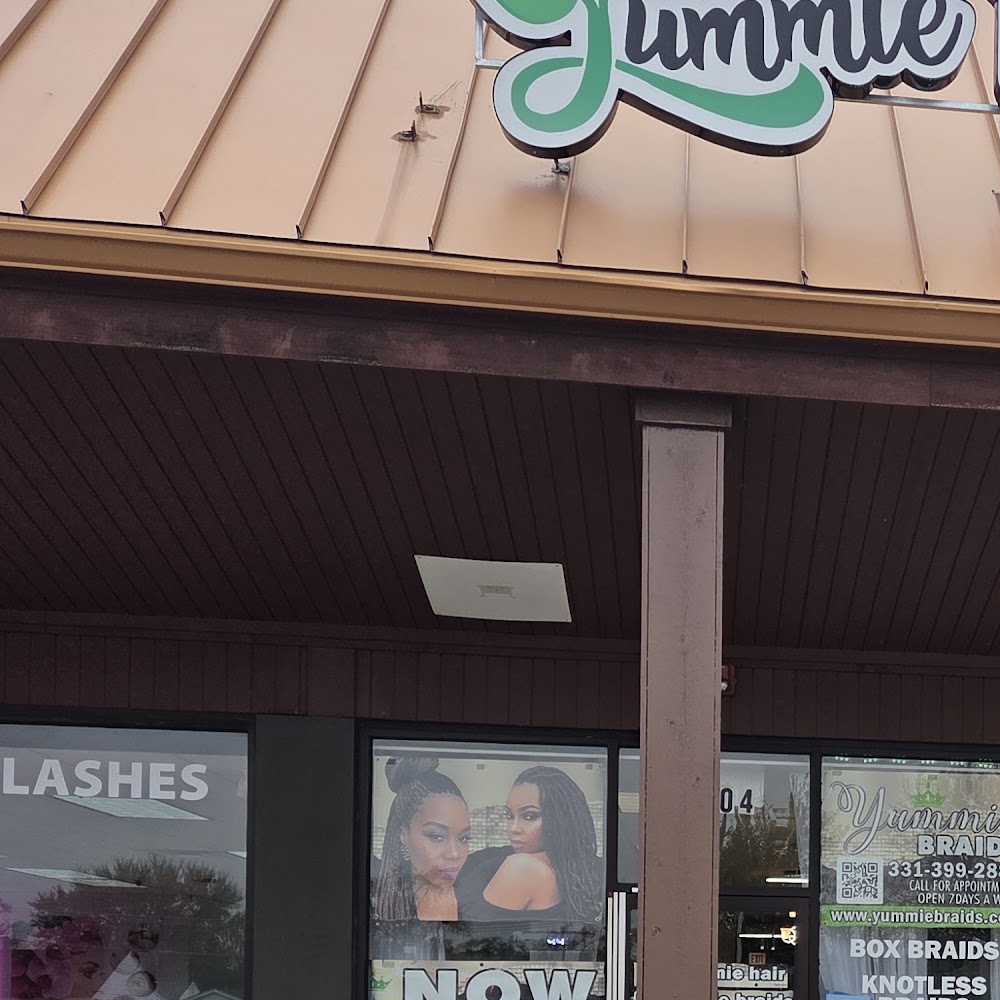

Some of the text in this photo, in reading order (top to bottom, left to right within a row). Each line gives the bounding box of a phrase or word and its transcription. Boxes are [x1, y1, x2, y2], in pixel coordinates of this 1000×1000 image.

[3, 757, 209, 800] LASHES
[909, 879, 930, 891] CALL
[933, 880, 951, 891] FOR
[917, 893, 945, 904] OPEN
[949, 893, 980, 905] 7DAYS
[983, 894, 991, 905] A
[850, 939, 1000, 960] BOX BRAIDS
[749, 965, 786, 981] hair
[861, 974, 988, 995] KNOTLESS
